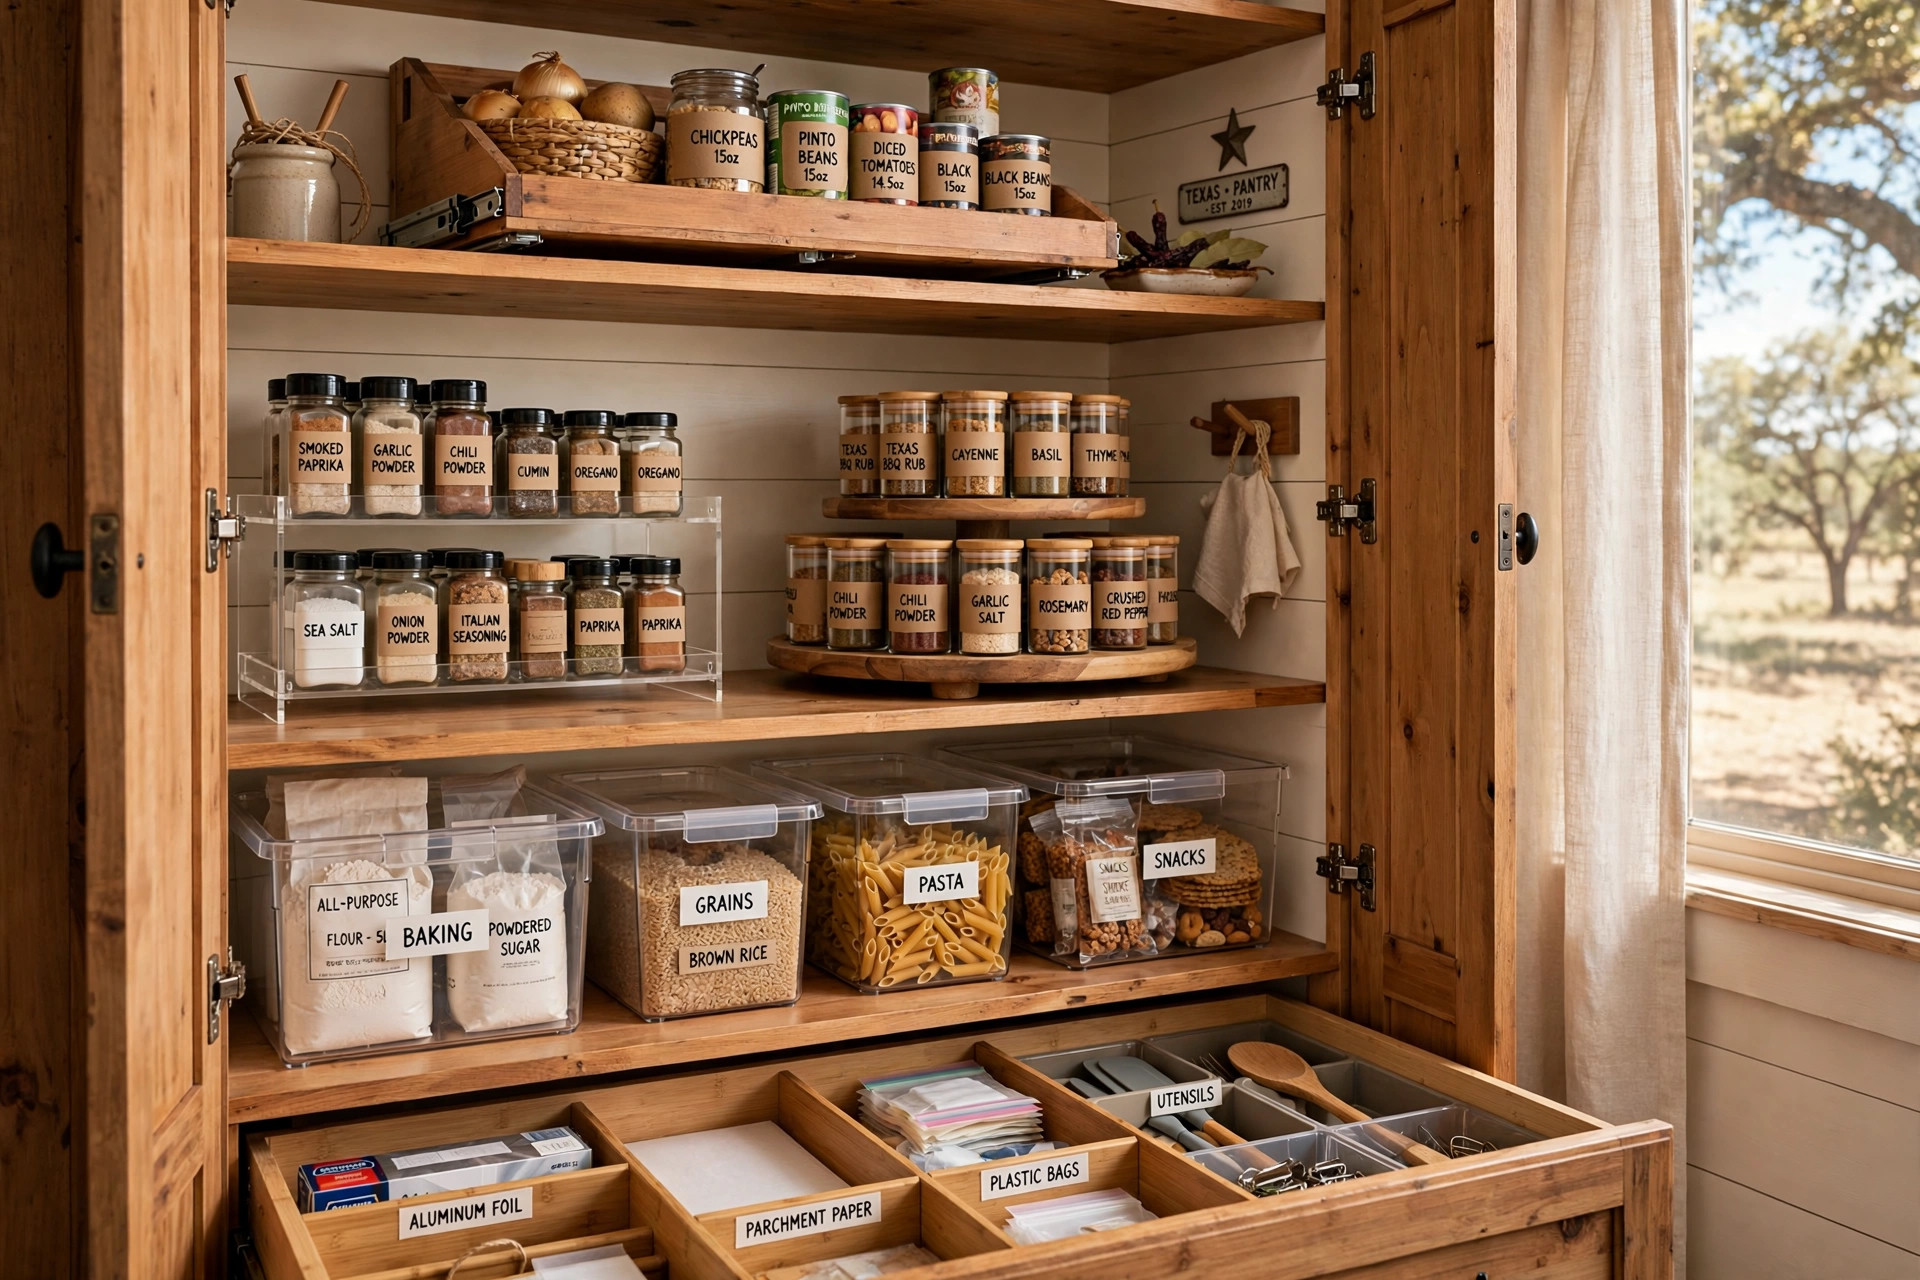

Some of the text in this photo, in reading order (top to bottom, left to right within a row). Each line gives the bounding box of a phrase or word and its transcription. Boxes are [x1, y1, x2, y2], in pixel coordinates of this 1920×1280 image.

[690, 129, 758, 149] CHICKPEAS
[799, 131, 835, 148] PINTO
[874, 141, 906, 156] DICED
[714, 149, 739, 164] 15oz
[798, 150, 838, 165] BEANS
[861, 158, 915, 175] TOMATOES
[937, 163, 972, 178] BLACK
[804, 168, 828, 182] 15oz
[985, 171, 1051, 187] BLACK BEANS
[872, 176, 904, 190] 14.5oz
[944, 180, 966, 193] 15oz
[1186, 172, 1278, 205] TEXAS PANTRY
[1014, 186, 1036, 200] 15oz
[1231, 198, 1252, 211] 2019
[299, 442, 343, 455] SMOKED
[374, 444, 412, 456] GARLIC
[450, 446, 477, 458] CHILI
[842, 444, 867, 456] TEXAS
[886, 442, 919, 455] TEXAS
[952, 448, 999, 461] CAYENNE
[1032, 448, 1062, 461] BASIL
[1086, 449, 1118, 462] THYME
[298, 459, 344, 471] PAPRIKA
[372, 460, 415, 473] POWDER
[444, 461, 486, 474] POWDER
[855, 458, 874, 471] RUB
[883, 458, 926, 471] BBQ RUB
[517, 466, 549, 478] CUMIN
[574, 467, 618, 478] OREGANO
[638, 467, 680, 479] OREGANO
[834, 591, 858, 604] CHILI
[900, 593, 927, 606] CHILI
[971, 594, 1009, 608] GARLIC
[1107, 591, 1146, 604] CRUSHED
[1040, 599, 1089, 613] ROSEMARY
[829, 607, 867, 620] POWDER
[895, 609, 936, 622] POWDER
[978, 611, 1005, 624] SALT
[1102, 608, 1121, 619] RED
[392, 615, 425, 628] ONION
[461, 614, 500, 627] ITALIAN
[580, 620, 621, 633] PAPRIKA
[642, 618, 682, 630] PAPRIKA
[304, 622, 358, 637] SEA SALT
[387, 632, 430, 644] POWDER
[453, 630, 507, 643] SEASONING
[1154, 848, 1205, 869] SNACKS
[919, 872, 964, 893] PASTA
[317, 892, 399, 913] ALL-PURPOSE
[695, 892, 753, 914] GRAINS
[489, 917, 551, 937] POWDERED
[327, 931, 363, 947] FLOUR
[403, 922, 472, 948] BAKING
[500, 938, 540, 957] SUGAR
[689, 945, 768, 969] BROWN RICE
[1157, 1086, 1215, 1109] UTENSILS
[990, 1162, 1079, 1191] PLASTIC BAGS
[409, 1197, 523, 1230] ALUMINUM FOIL
[746, 1201, 872, 1238] PARCHMENT PAPER
